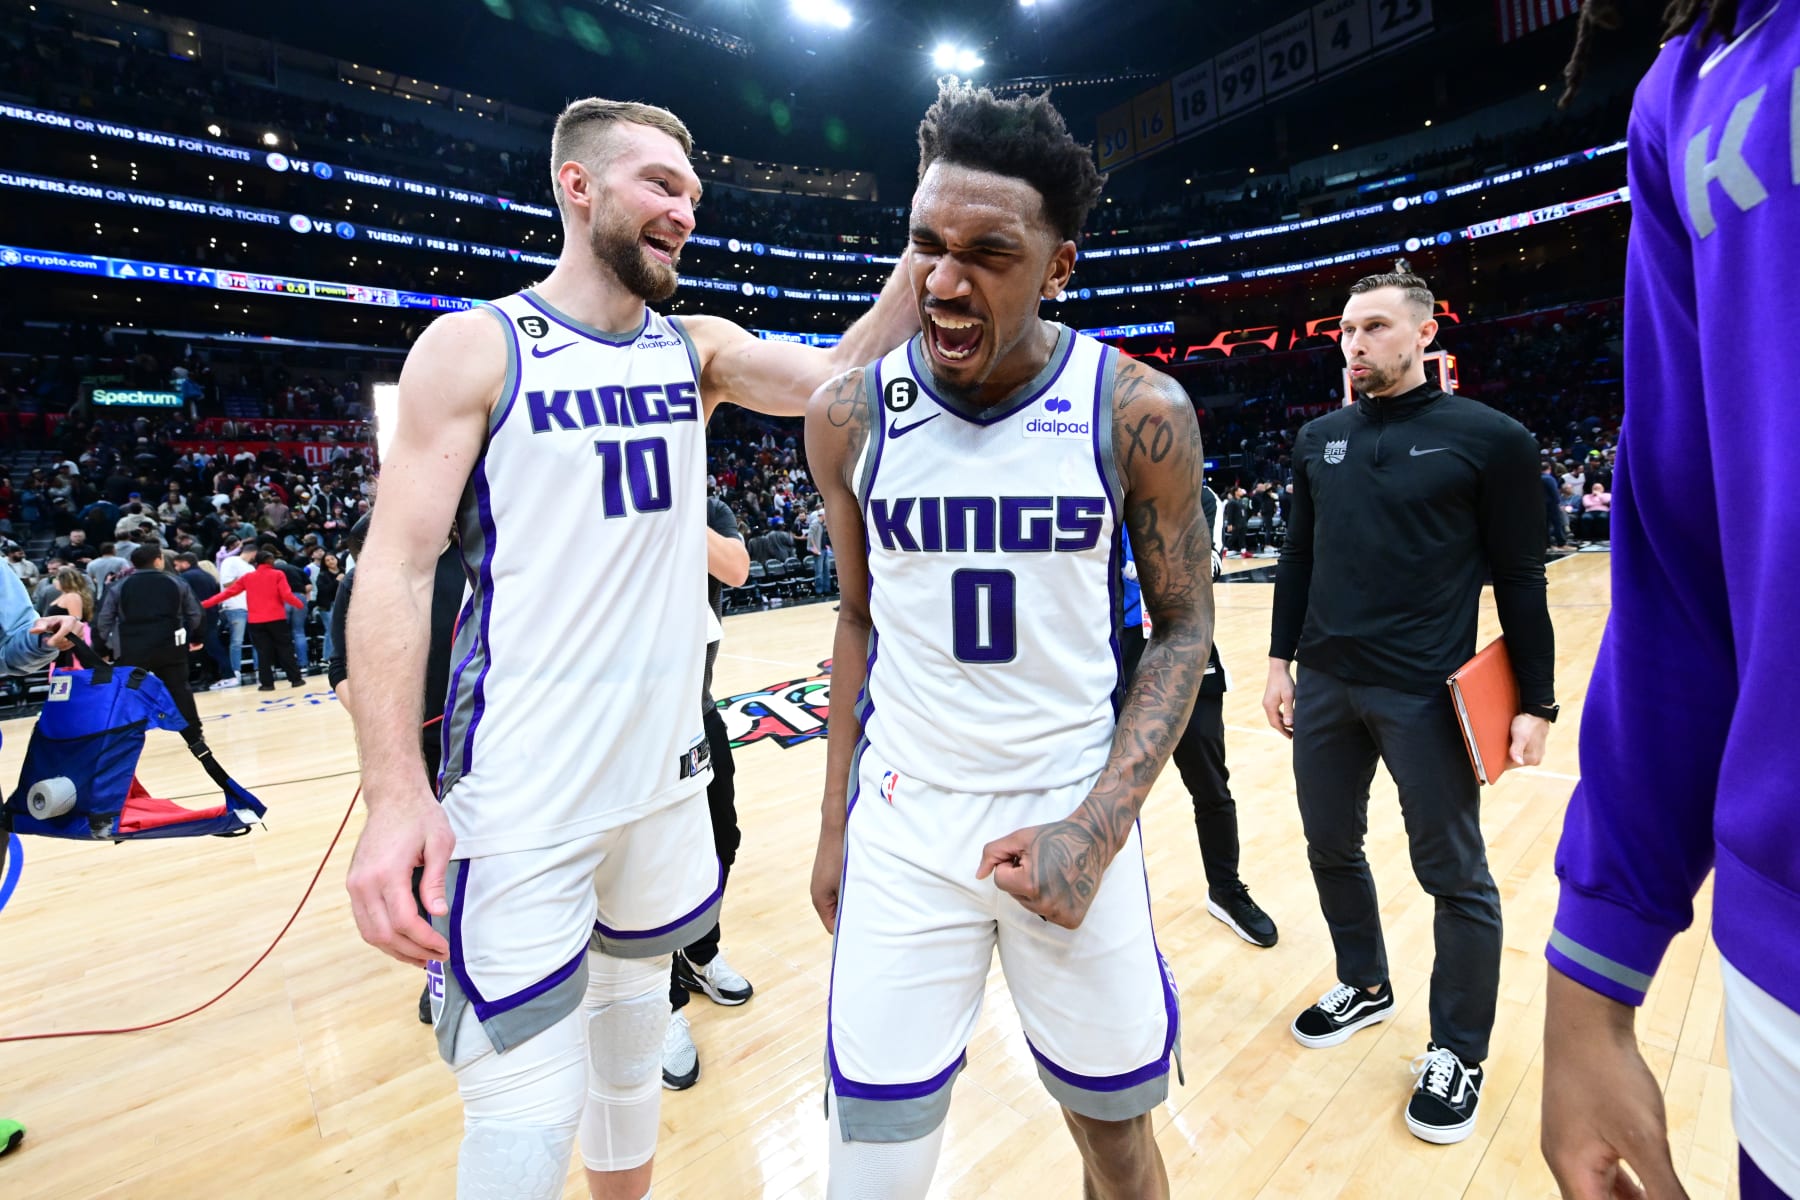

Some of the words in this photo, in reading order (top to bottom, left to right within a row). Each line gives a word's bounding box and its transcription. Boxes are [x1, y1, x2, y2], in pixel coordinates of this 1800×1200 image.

[1380, 0, 1422, 32] 23
[1331, 19, 1352, 49] 4
[1270, 41, 1307, 80] 20
[1222, 64, 1256, 103] 99
[1182, 90, 1206, 121] 18
[1141, 112, 1163, 138] 16
[74, 120, 94, 132] OR
[97, 124, 134, 139] VIVID
[137, 132, 176, 147] SEATS
[178, 139, 203, 152] FOR
[205, 144, 250, 161] TICKETS
[1103, 127, 1127, 157] 30
[290, 160, 309, 173] VS
[1446, 181, 1483, 197] TUESDAY
[1493, 174, 1510, 184] FEB
[1555, 158, 1568, 168] PM
[0, 173, 103, 198] CLIPPERS.COM
[105, 190, 126, 201] OR
[128, 193, 165, 208] VIVID
[168, 200, 206, 214] SEATS
[209, 206, 233, 218] FOR
[235, 209, 280, 225] TICKETS
[344, 170, 391, 187] TUESDAY
[404, 182, 423, 194] FEB
[424, 187, 437, 197] 28
[449, 191, 468, 203] 7:00
[470, 196, 484, 206] PM
[1408, 197, 1421, 206] VS
[1229, 231, 1244, 240] VISIT
[1290, 222, 1300, 231] OR
[1320, 214, 1341, 225] SEATS
[1341, 210, 1356, 220] FOR
[1357, 204, 1384, 217] TICKETS
[1536, 206, 1563, 222] 175
[312, 220, 332, 234] VS
[366, 229, 413, 245] TUESDAY
[426, 239, 445, 250] FEB
[446, 242, 459, 252] 28
[471, 246, 491, 257] 7:00
[492, 249, 506, 259] PM
[741, 243, 752, 252] VS
[1421, 237, 1435, 247] VS
[23, 253, 97, 270] crypto.com
[1303, 261, 1314, 269] OR
[1334, 252, 1356, 263] SEATS
[1356, 248, 1371, 259] FOR
[1372, 243, 1400, 256] TICKETS
[142, 265, 211, 283] DELTA
[228, 275, 246, 287] 175
[254, 279, 273, 290] 176
[286, 283, 306, 293] 0.0
[755, 286, 766, 295] VS
[1068, 290, 1078, 298] VS
[437, 298, 470, 310] ULTRA
[524, 319, 543, 336] 6
[1140, 324, 1171, 334] DELTA
[637, 337, 681, 350] dialpad
[92, 389, 177, 405] Spectrum
[891, 381, 909, 408] 6
[525, 381, 698, 434] KINGS
[1026, 419, 1089, 436] dialpad
[594, 436, 673, 519] 10
[870, 495, 1106, 552] KINGS
[951, 568, 1017, 664] 0
